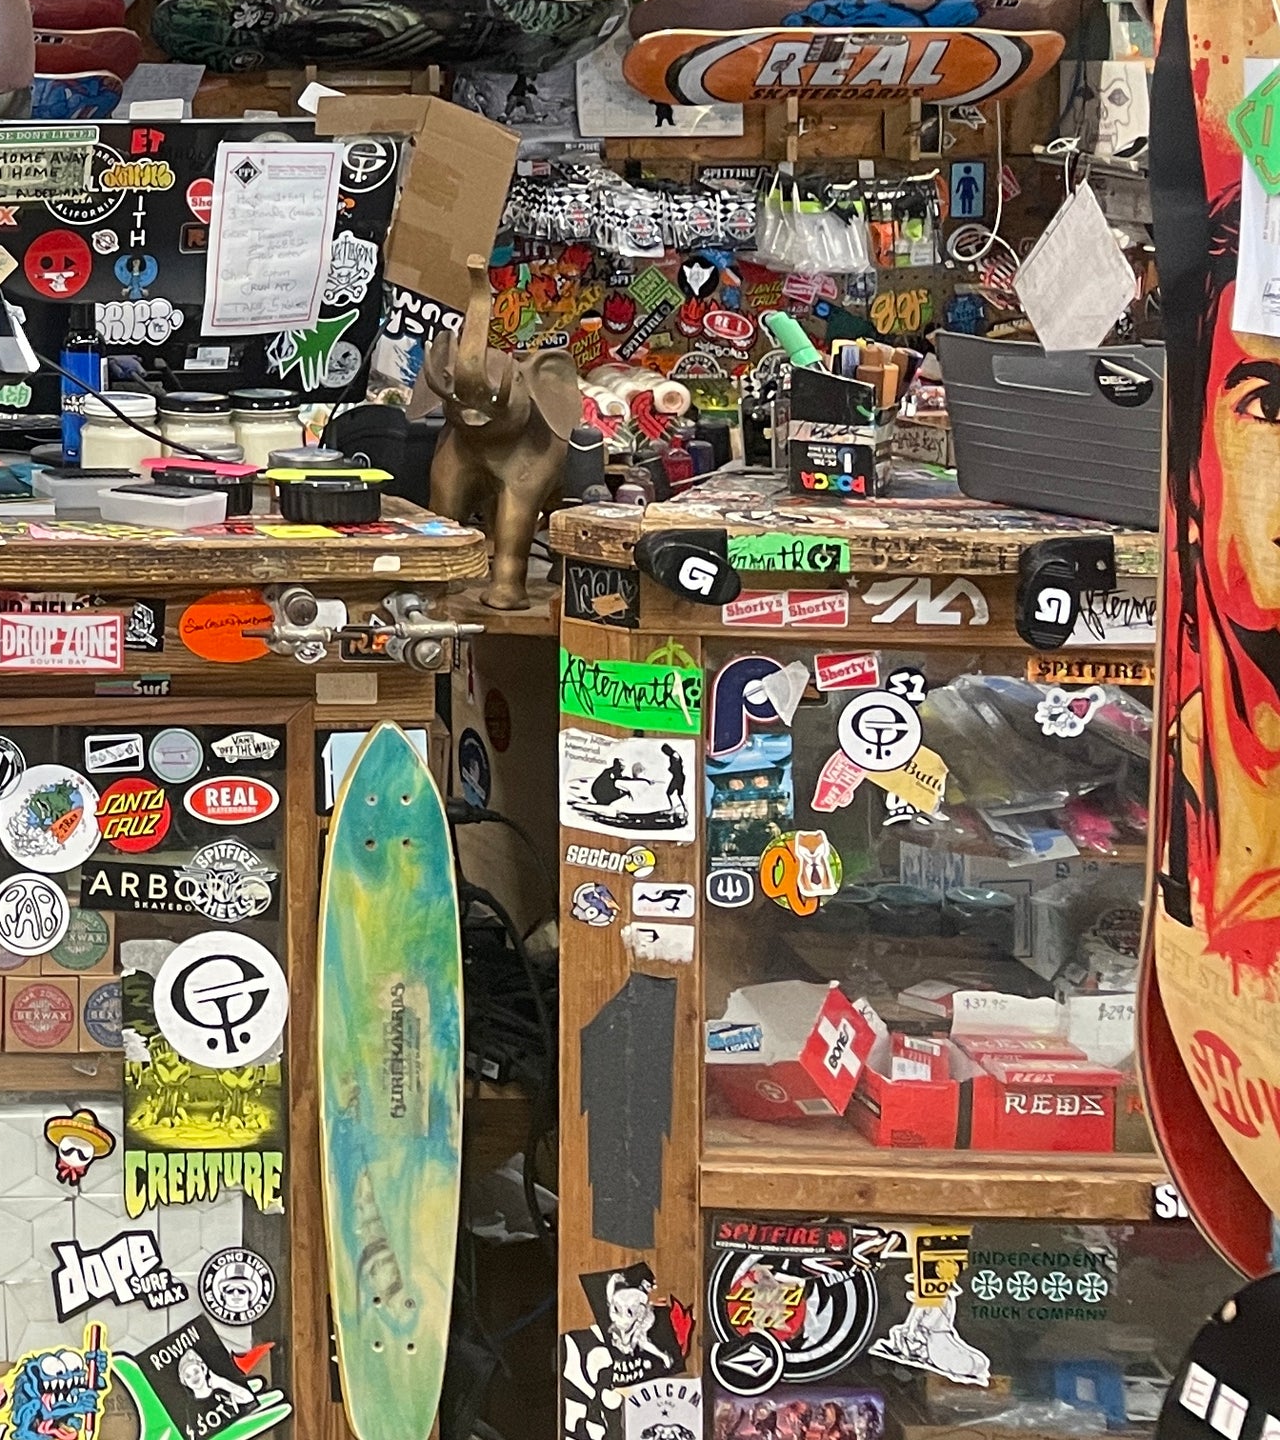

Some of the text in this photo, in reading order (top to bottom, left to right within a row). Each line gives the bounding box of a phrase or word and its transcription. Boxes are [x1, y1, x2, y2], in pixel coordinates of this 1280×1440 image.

[756, 41, 951, 87] REAL
[16, 131, 49, 140] DONT
[52, 129, 96, 139] LITTER
[131, 128, 165, 155] ET
[51, 151, 89, 163] AWAY
[12, 167, 61, 178] HOME
[799, 472, 867, 494] POSCA
[725, 593, 782, 619] Shorty's
[788, 593, 846, 619] Shorty's
[0, 622, 118, 658] DROP ZONE
[819, 658, 876, 684] Shorty's
[1036, 659, 1146, 679] SPITFIRE
[96, 788, 166, 816] SANTA
[205, 787, 258, 806] REAL
[104, 814, 160, 839] CRUZ
[195, 844, 258, 870] SPITFIRE
[1004, 1092, 1105, 1116] REDS
[125, 1149, 283, 1220] CREATURE
[717, 1223, 822, 1244] SPITFIRE
[972, 1251, 1108, 1269] INDEPENDENT
[131, 1273, 170, 1293] SURF
[148, 1285, 186, 1310] WAX
[972, 1306, 1108, 1320] TRUCK COMPANY
[627, 1380, 702, 1410] VOLCOM
